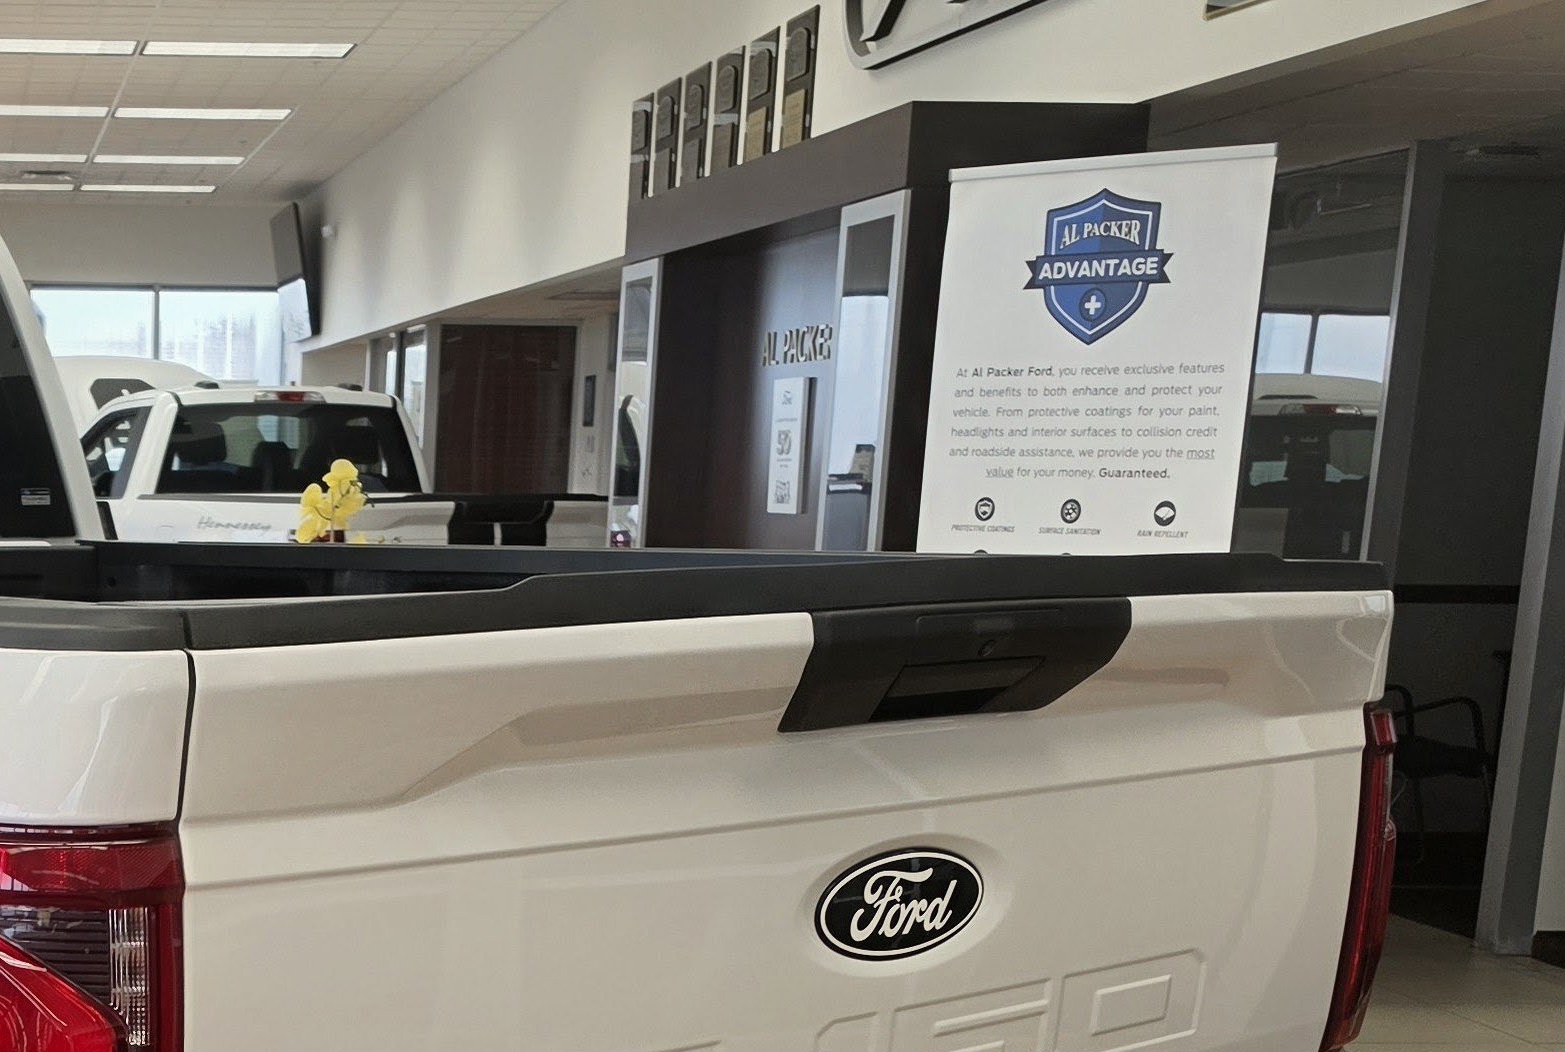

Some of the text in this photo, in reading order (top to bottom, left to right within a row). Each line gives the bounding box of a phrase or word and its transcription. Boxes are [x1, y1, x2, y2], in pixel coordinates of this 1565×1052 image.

[1060, 220, 1141, 249] AL PACKER
[1039, 257, 1158, 280] ADVANTAGE
[763, 331, 779, 366] AL
[956, 368, 967, 377] At
[972, 367, 982, 377] Al
[987, 367, 1023, 376] Packer
[1059, 367, 1076, 378] you
[1081, 365, 1119, 375] receive
[1124, 364, 1174, 375] exclusive
[1179, 363, 1224, 374] features
[954, 385, 1222, 397] and benefits to both enhance and protect your
[953, 407, 990, 417] vehicle.
[996, 407, 1023, 417] From
[1028, 407, 1079, 418] protective
[1085, 407, 1132, 418] coatings
[1138, 406, 1153, 416] for
[1159, 407, 1183, 418] your
[951, 427, 1217, 439] headlights and interior surfaces to collision credit
[949, 447, 968, 457] and
[971, 447, 1015, 457] roadside
[1079, 449, 1094, 457] we
[1097, 447, 1139, 458] provide
[1143, 449, 1162, 459] you
[1166, 447, 1183, 457] the
[1186, 448, 1215, 459] most
[986, 467, 1170, 479] value for your money. Guaranteed.
[850, 867, 957, 942] Ford
